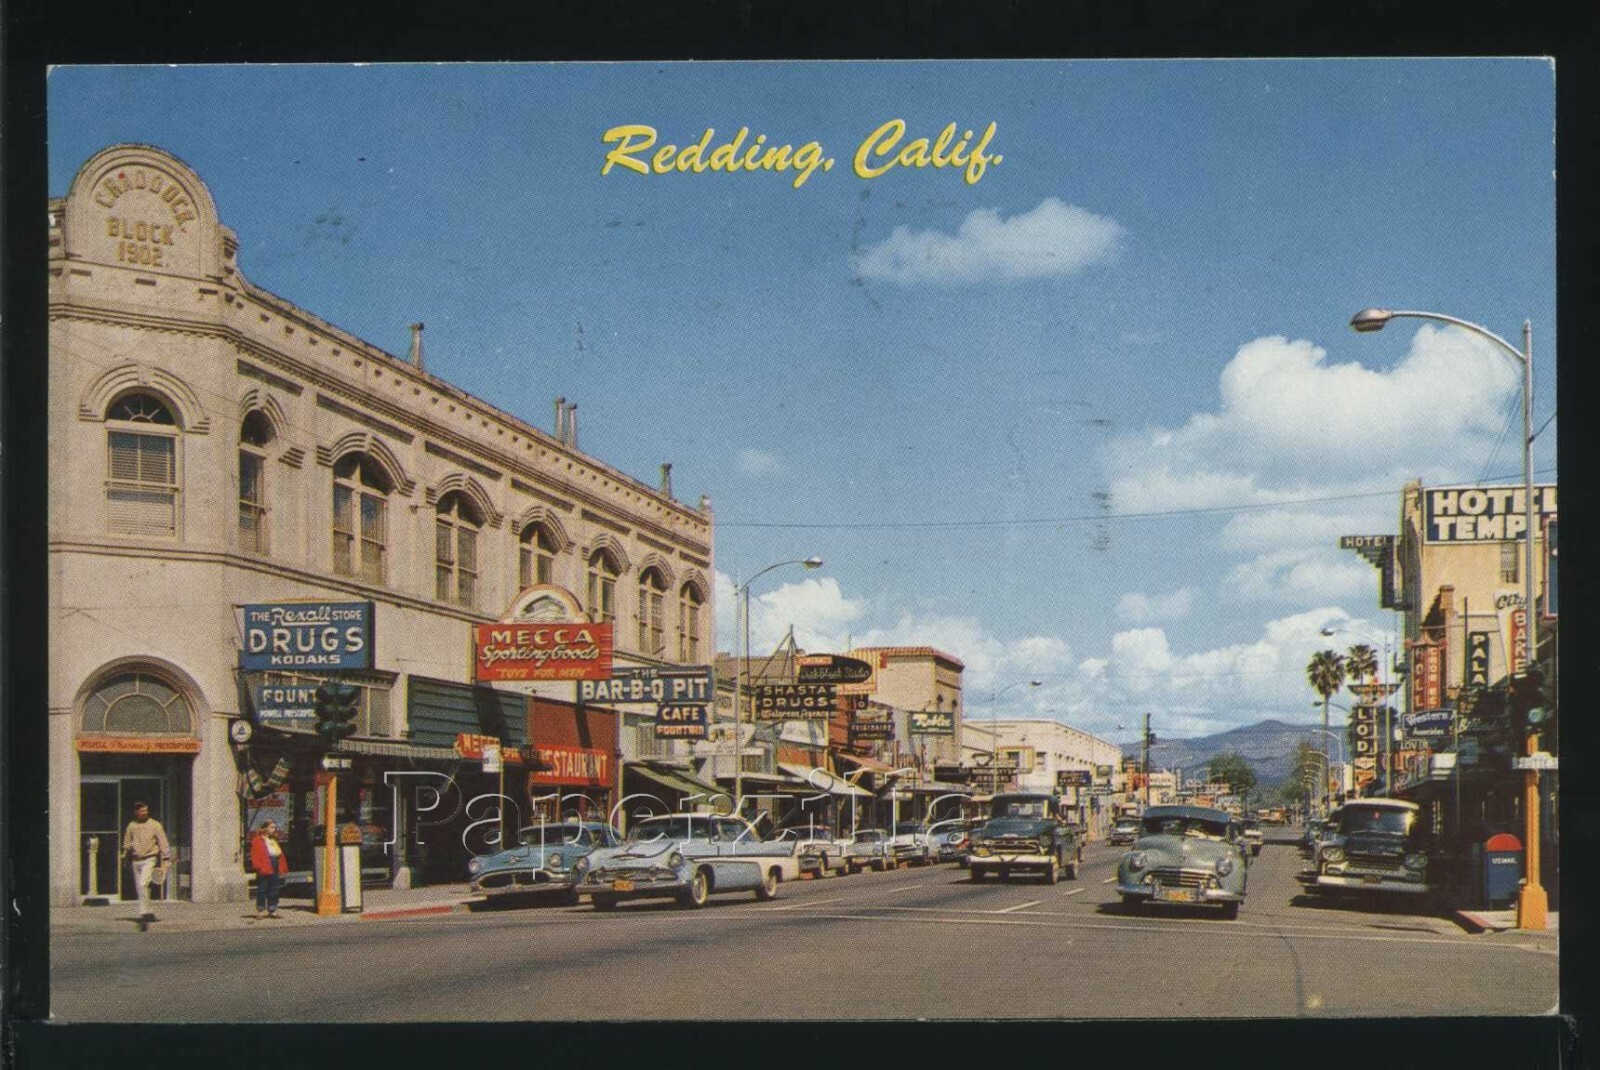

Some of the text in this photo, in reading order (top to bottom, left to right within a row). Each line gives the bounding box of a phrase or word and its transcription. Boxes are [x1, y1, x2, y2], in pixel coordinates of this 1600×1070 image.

[106, 216, 174, 246] BLOCK
[1433, 488, 1557, 515] HOTEL
[250, 606, 363, 627] THE Rexall STORE
[249, 627, 364, 653] DRUGS
[491, 629, 594, 645] MECCA
[271, 654, 341, 665] KODAKS
[533, 668, 555, 678] FOR
[633, 669, 658, 678] THE
[582, 678, 709, 702] BAR-B-Q PIT
[763, 686, 827, 695] SHASTA
[763, 697, 829, 708] DRUGS
[661, 706, 700, 721] CAFE
